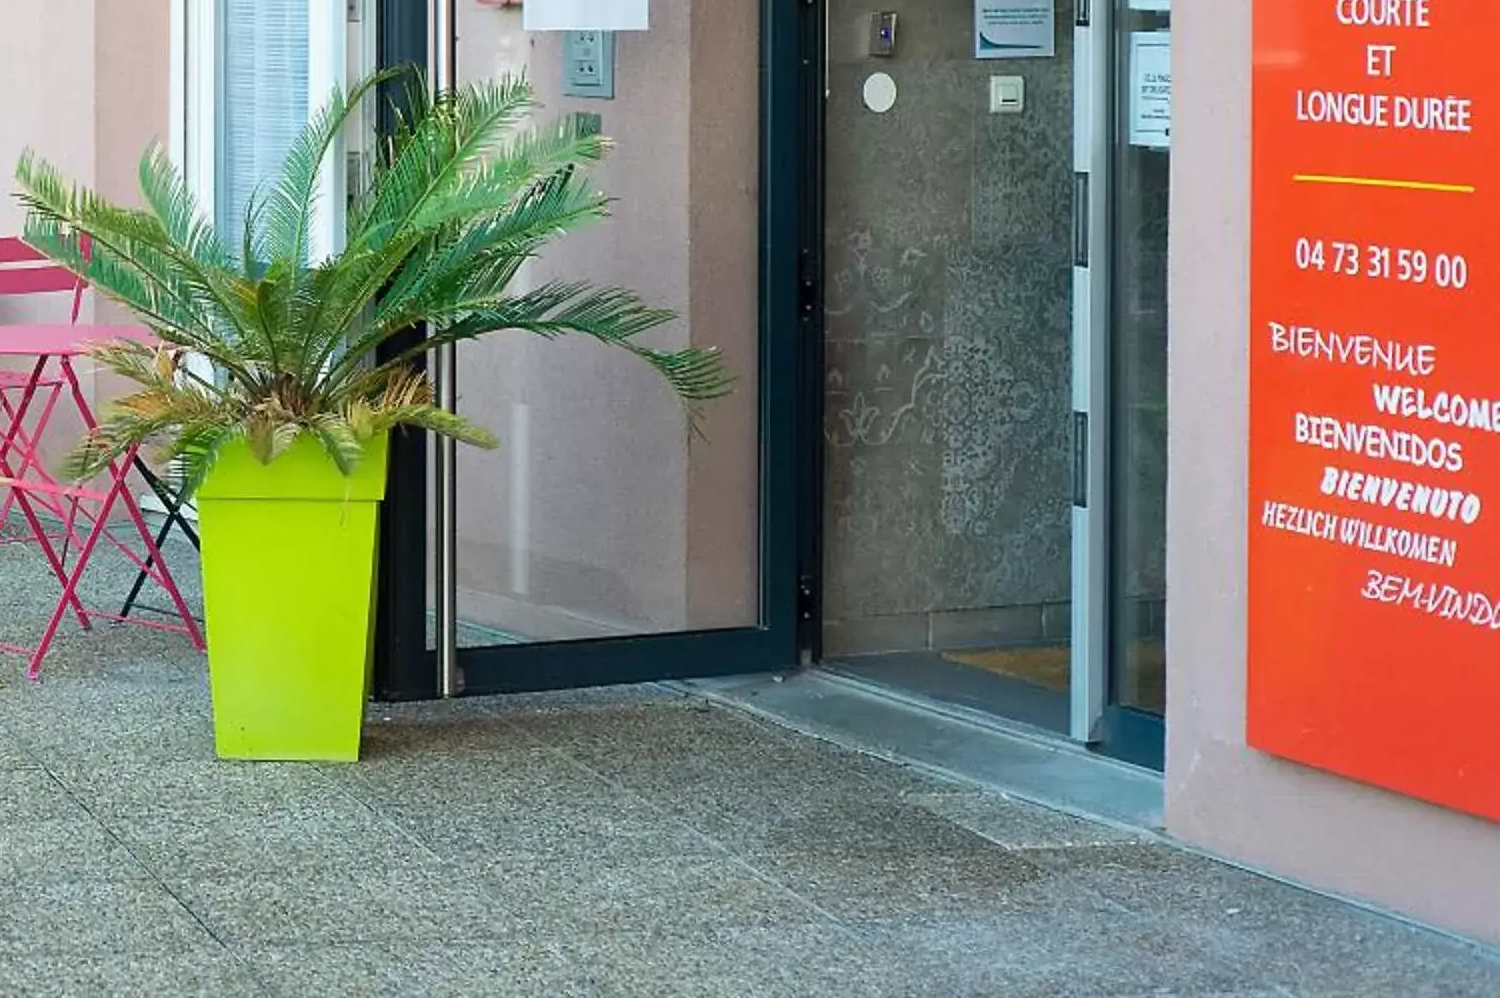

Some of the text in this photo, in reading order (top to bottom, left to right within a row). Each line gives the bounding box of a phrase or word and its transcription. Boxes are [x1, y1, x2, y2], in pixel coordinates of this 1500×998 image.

[1366, 44, 1397, 76] ET
[1296, 89, 1471, 132] LONGUE DURÉE
[1295, 238, 1467, 289] 04 73 31 59 00
[1269, 321, 1435, 376] BIENVENUE
[1372, 383, 1500, 433] WELCOME
[1295, 413, 1463, 471] BIENVENIDOS
[1320, 466, 1481, 524] BIENVENUTO
[1261, 501, 1456, 567] HEZLICH WILLKOMEN
